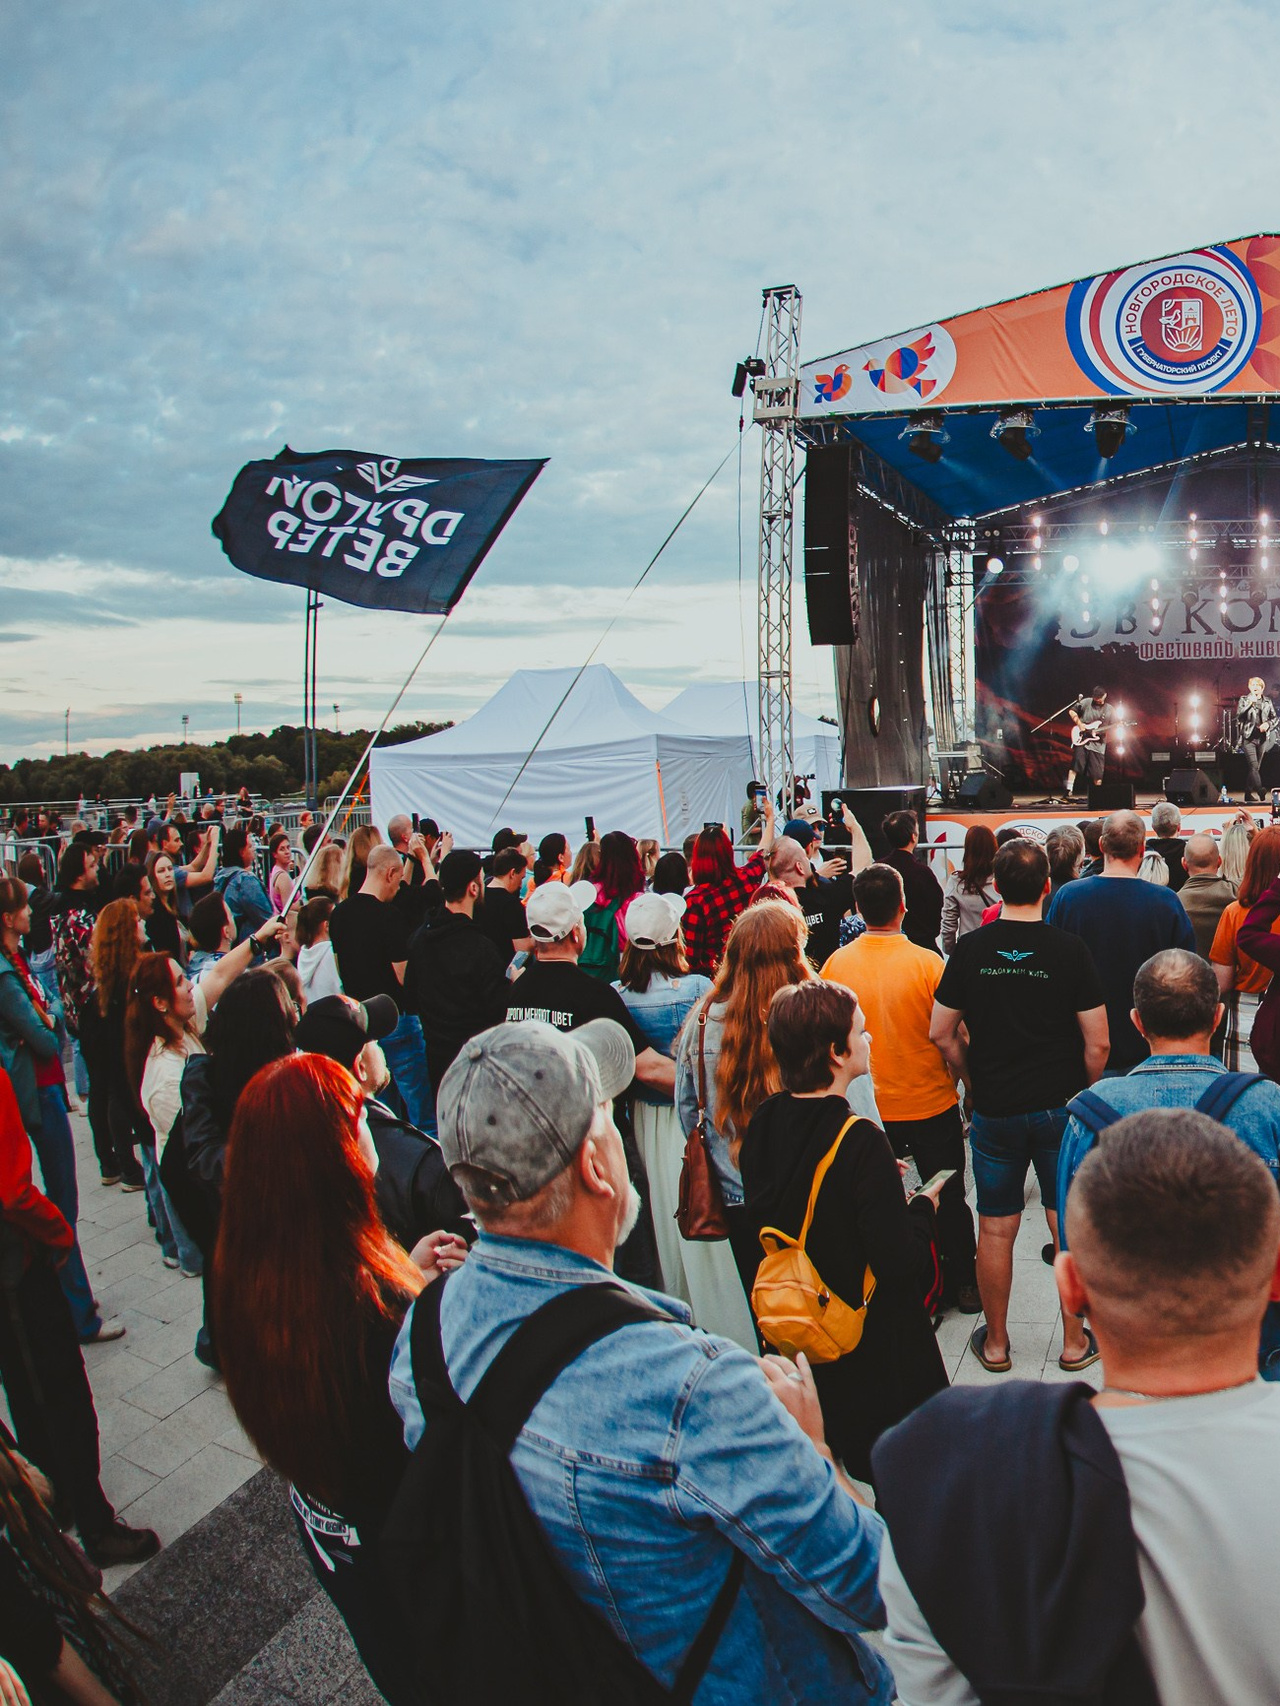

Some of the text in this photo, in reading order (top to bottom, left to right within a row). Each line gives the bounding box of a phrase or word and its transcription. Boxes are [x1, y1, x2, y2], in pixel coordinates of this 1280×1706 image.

[1125, 273, 1238, 337] НОВГОРОДСКОЕ ЛЕТО
[1136, 347, 1223, 374] ГУБЕРНАТОРСКИЙ ПРОЕКТ
[1139, 640, 1234, 660] ФЕСТИВАЛЬ
[806, 912, 824, 927] ЦВЕТ
[551, 1010, 574, 1027] ЦВЕТ
